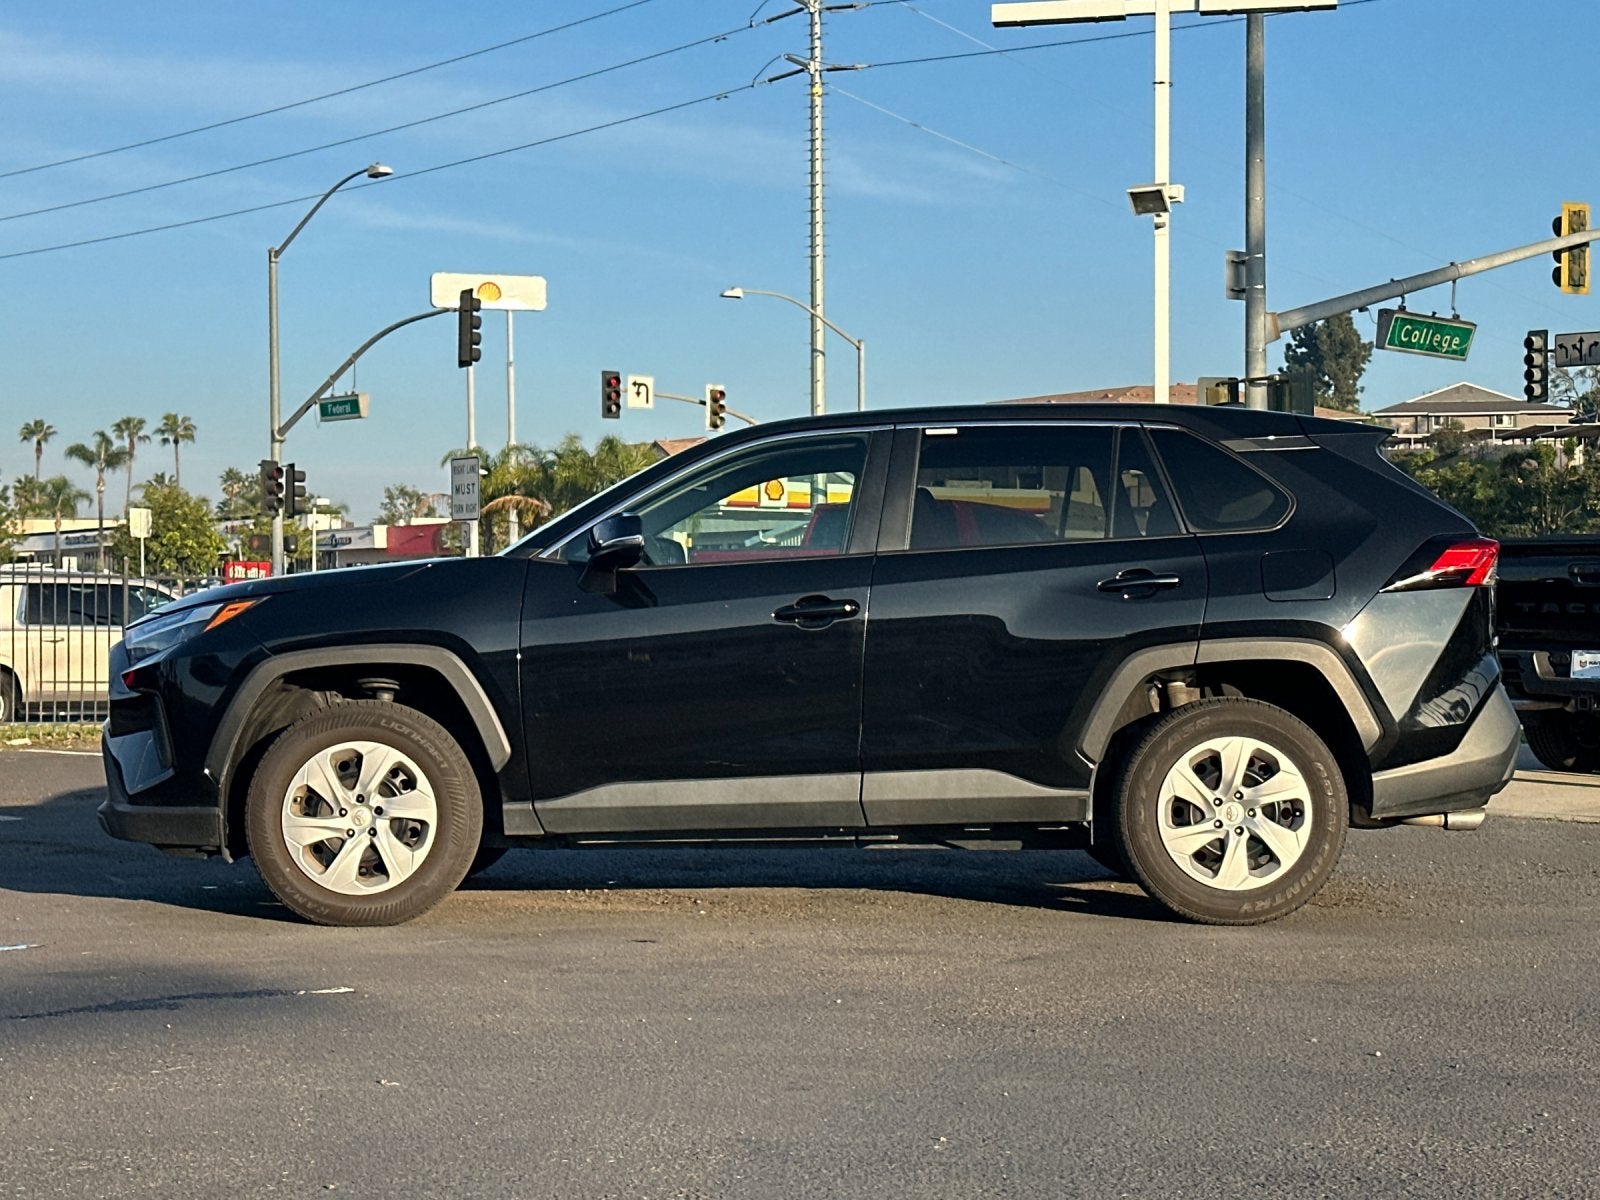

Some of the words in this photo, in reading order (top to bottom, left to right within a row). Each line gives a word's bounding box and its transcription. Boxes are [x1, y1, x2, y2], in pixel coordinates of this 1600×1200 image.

[1401, 324, 1460, 353] College
[327, 402, 351, 415] Federal
[466, 463, 477, 474] LANE
[454, 482, 475, 496] MUST
[380, 719, 449, 769] LIONHART
[1239, 841, 1330, 914] COUNTRY
